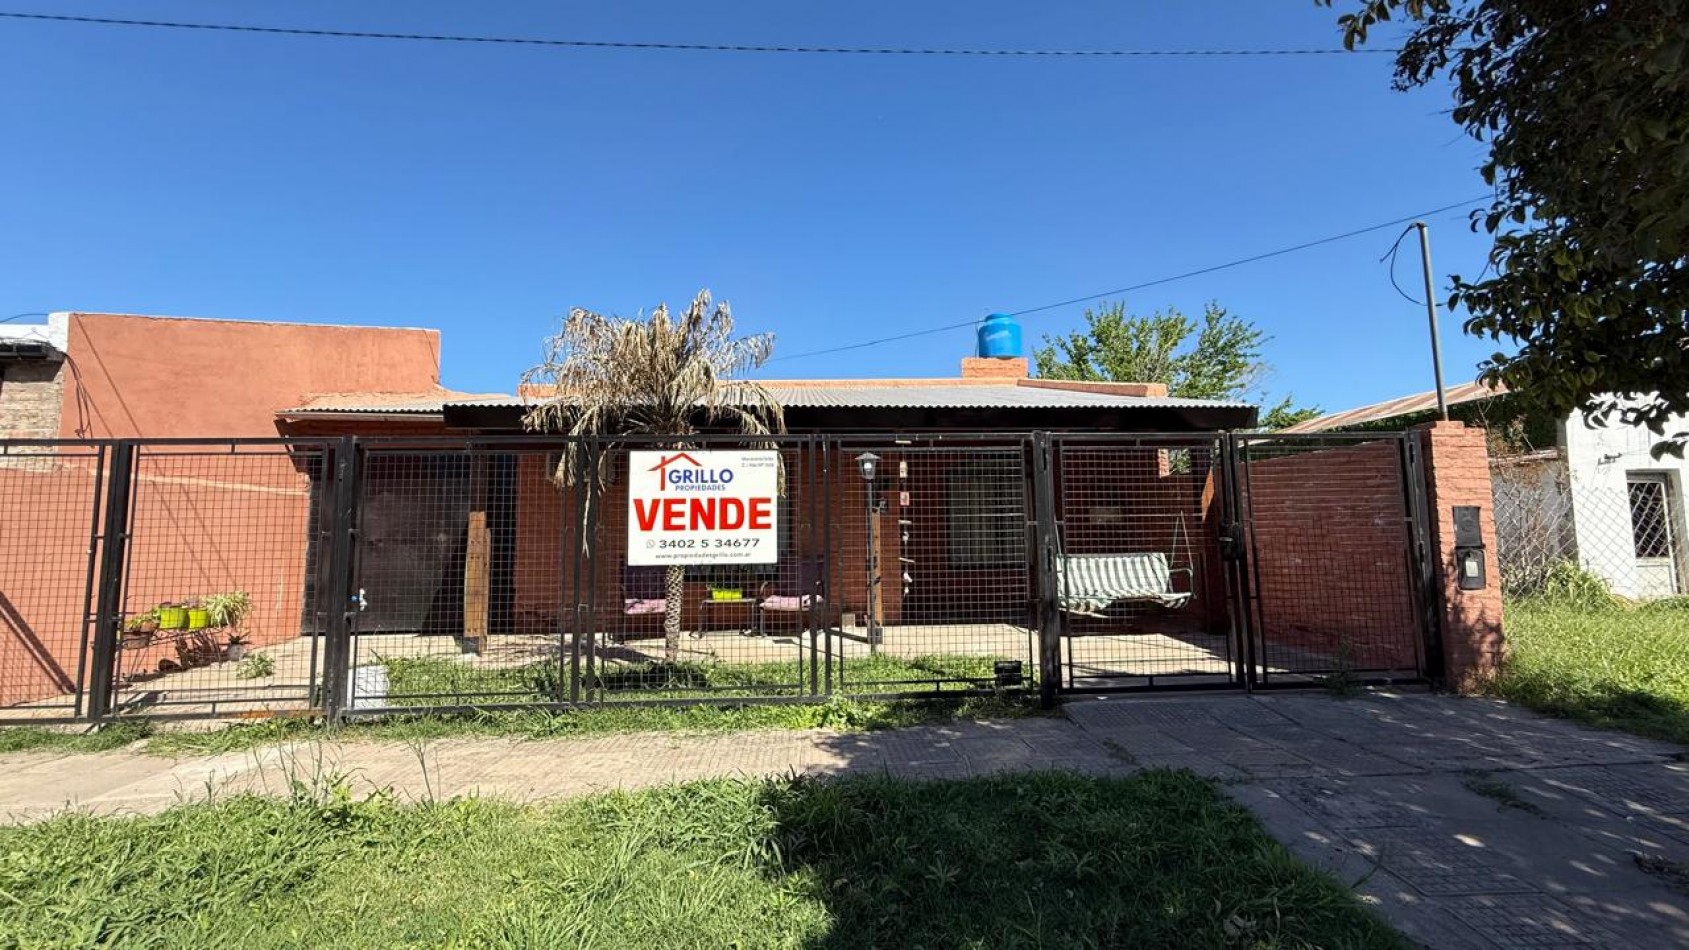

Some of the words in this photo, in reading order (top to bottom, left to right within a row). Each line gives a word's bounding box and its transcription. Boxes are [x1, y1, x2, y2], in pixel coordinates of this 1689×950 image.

[669, 468, 733, 484] GRILLO
[633, 497, 772, 532] VENDE
[659, 539, 695, 549] 3402
[701, 539, 709, 548] 5
[714, 538, 760, 548] 34677
[655, 551, 752, 559] www.propiedadesgrillo.com.ar
